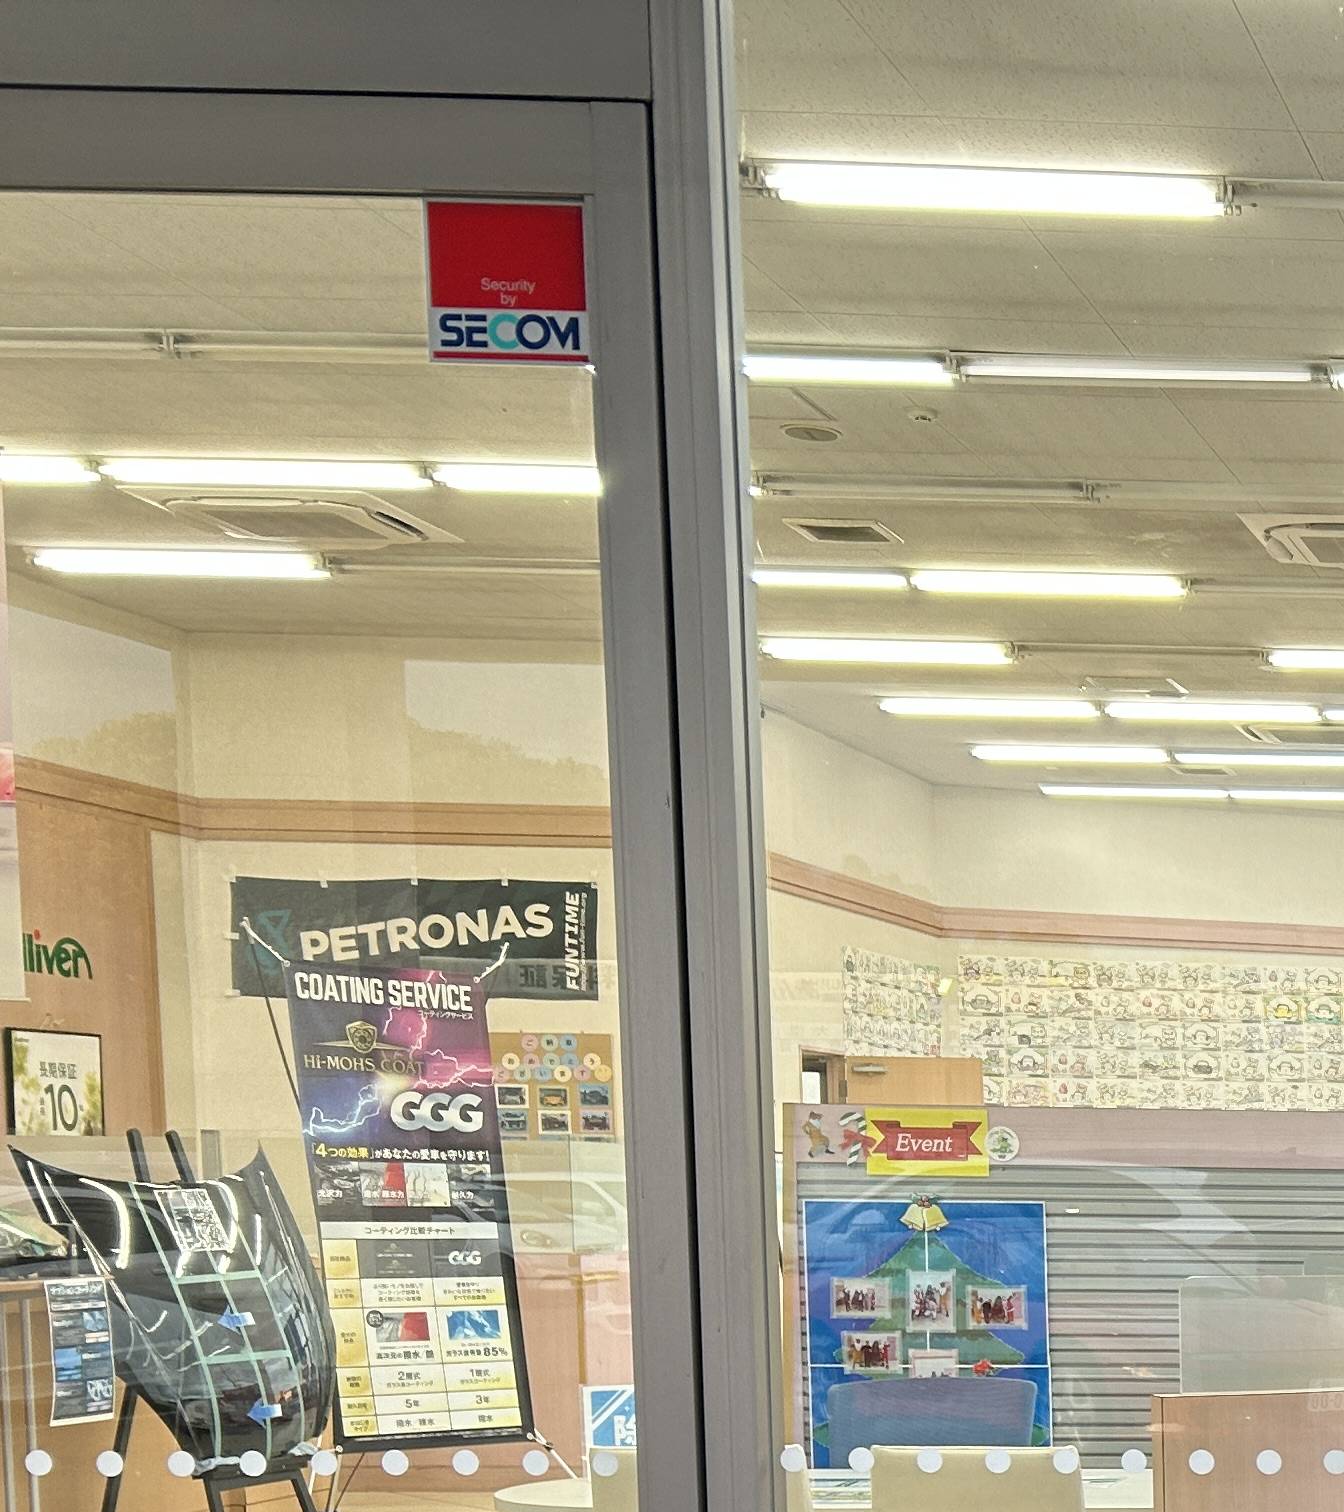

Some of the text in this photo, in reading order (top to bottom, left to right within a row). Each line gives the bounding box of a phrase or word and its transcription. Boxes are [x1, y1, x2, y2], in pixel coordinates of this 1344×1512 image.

[480, 277, 536, 294] Security
[500, 292, 517, 307] by
[439, 313, 581, 350] SECOM
[300, 904, 554, 961] PETRONAS
[564, 891, 581, 991] FUNTIME
[294, 972, 473, 1012] COATING SERVICE
[380, 1059, 424, 1074] COAT
[44, 1084, 79, 1131] 10
[390, 1091, 484, 1132] GGG
[895, 1133, 953, 1152] Event
[448, 1251, 482, 1265] GGG
